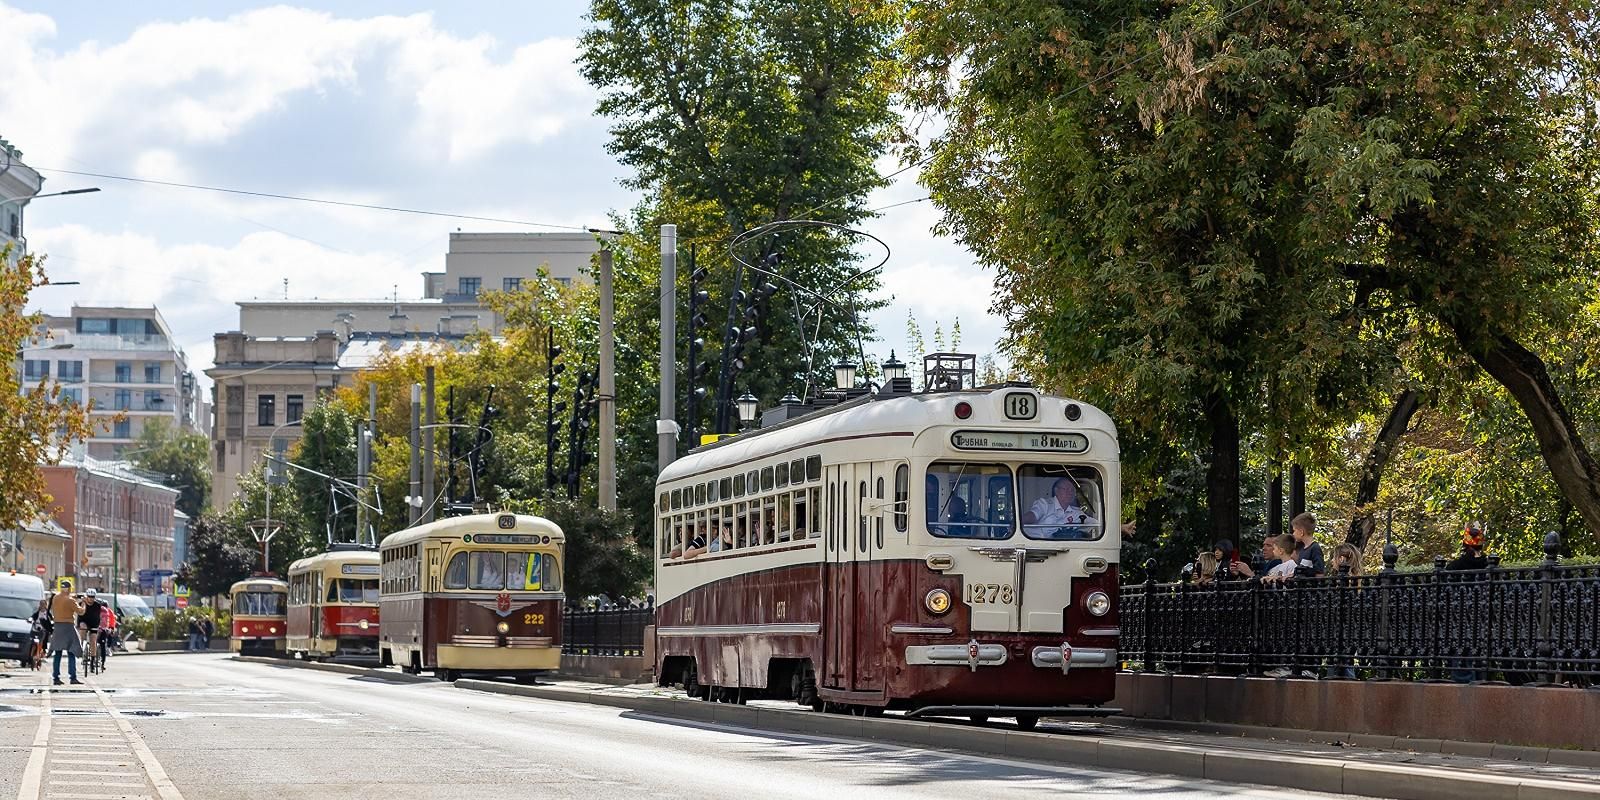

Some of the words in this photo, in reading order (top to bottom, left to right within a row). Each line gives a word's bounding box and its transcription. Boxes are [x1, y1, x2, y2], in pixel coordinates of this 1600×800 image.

[1011, 397, 1029, 416] 18
[1040, 434, 1048, 448] 8
[501, 517, 513, 527] 26
[966, 583, 1013, 604] 1278
[524, 613, 545, 625] 222
